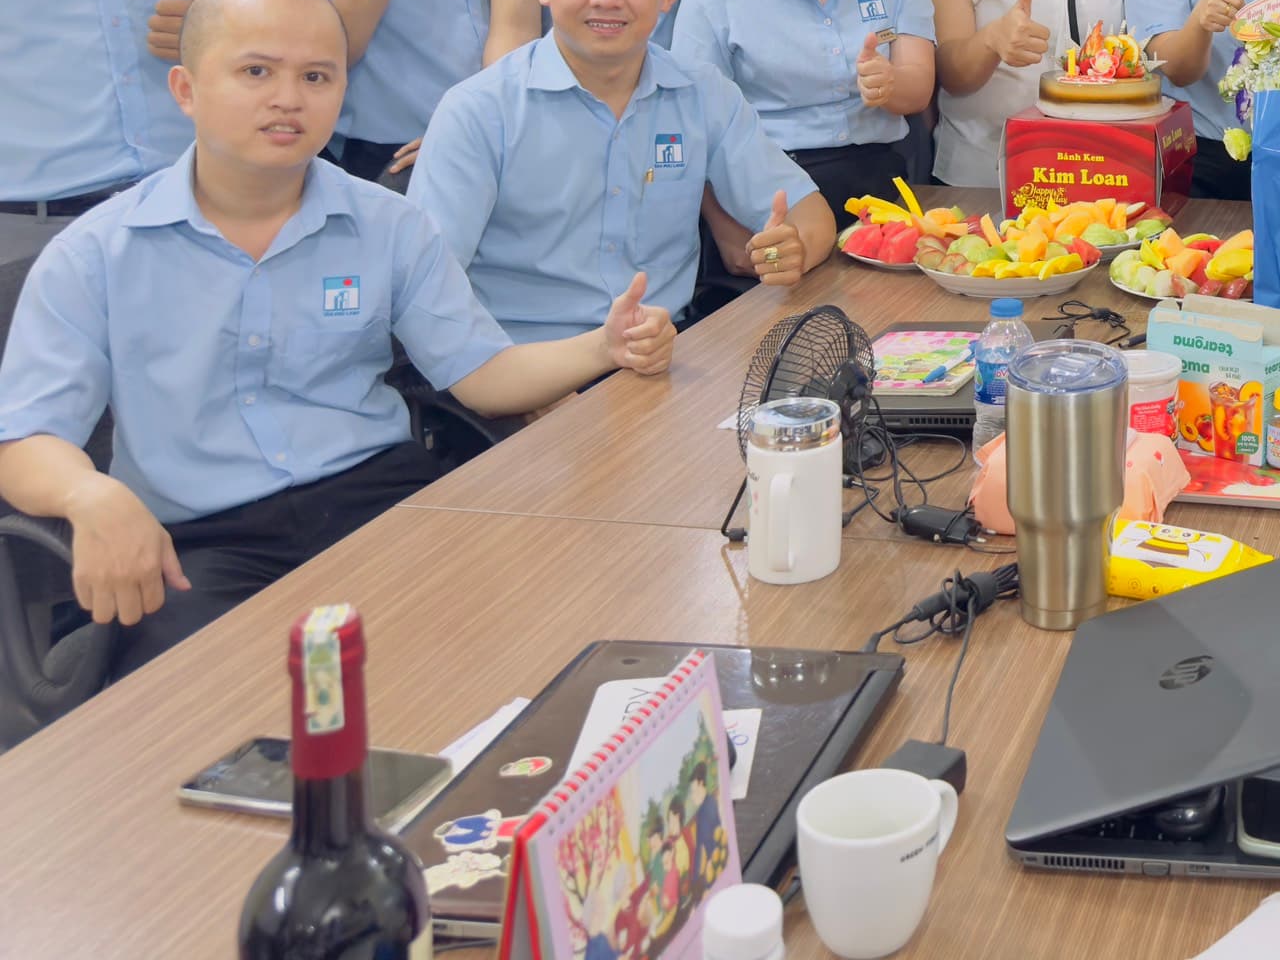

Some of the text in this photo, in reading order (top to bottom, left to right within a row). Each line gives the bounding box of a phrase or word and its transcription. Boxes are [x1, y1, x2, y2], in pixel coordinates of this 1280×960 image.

[1057, 152, 1104, 162] Bánh Kem
[1033, 167, 1129, 187] Kim Loan
